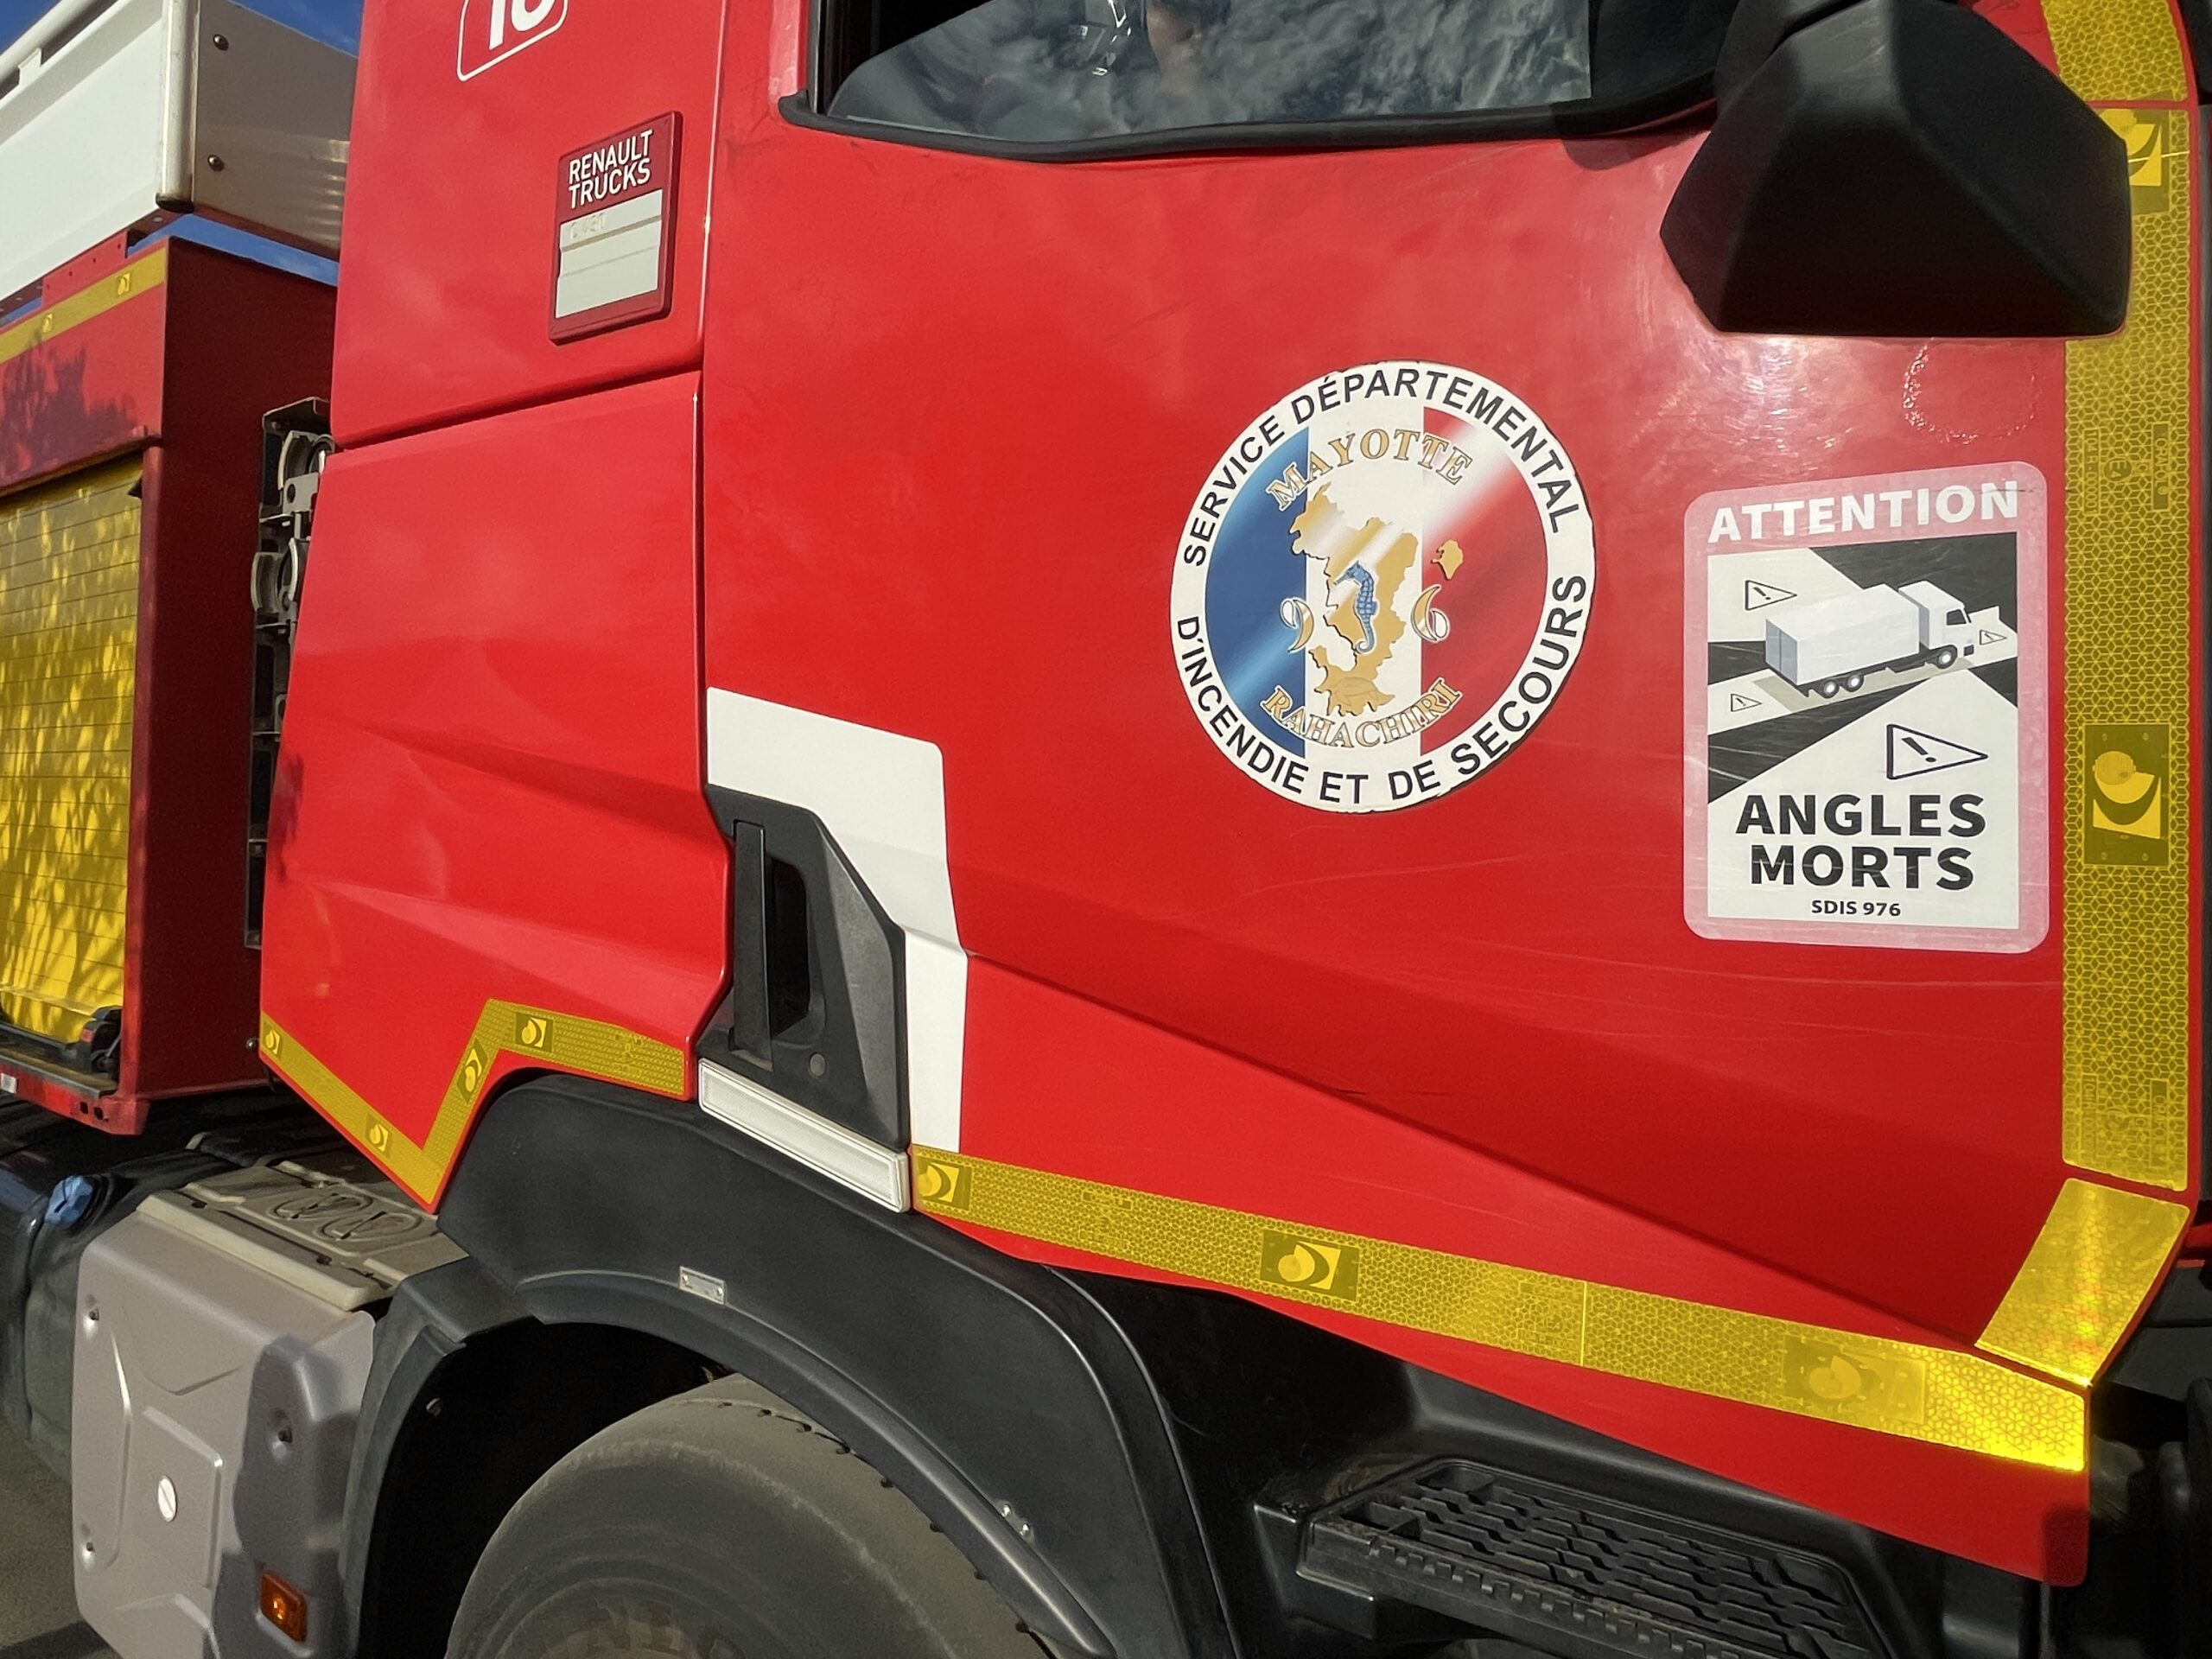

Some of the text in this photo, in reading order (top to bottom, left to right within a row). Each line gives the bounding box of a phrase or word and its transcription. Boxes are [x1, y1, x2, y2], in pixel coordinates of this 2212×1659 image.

[568, 158, 652, 209] TRUCKS
[569, 130, 652, 184] RENAULT
[1183, 368, 1580, 567] SERVICE DÉPARTEMENTAL
[1266, 429, 1473, 512] MAYOTTE
[1707, 480, 2018, 544] ATTENTION
[1177, 575, 1587, 804] D'INCENDIE ET DE SECOURS
[1261, 677, 1462, 749] RAHACHIRI
[1735, 794, 1987, 837] ANGLES
[1750, 844, 1974, 890] MORTS
[1811, 899, 1902, 918] SDIS 976
